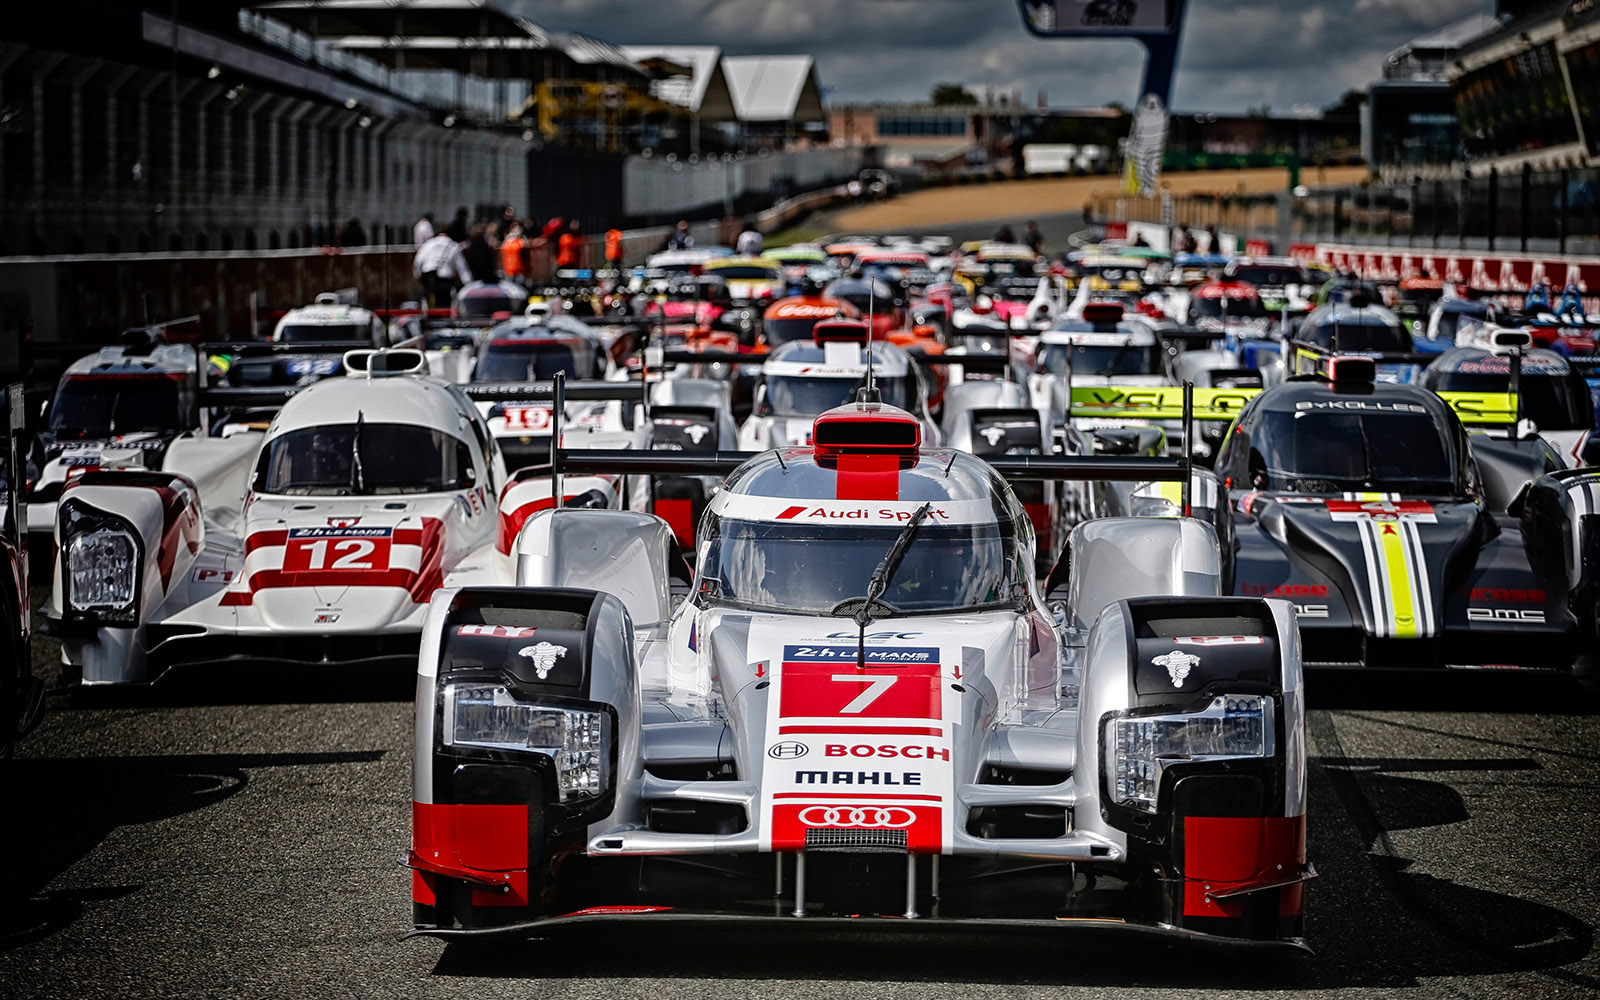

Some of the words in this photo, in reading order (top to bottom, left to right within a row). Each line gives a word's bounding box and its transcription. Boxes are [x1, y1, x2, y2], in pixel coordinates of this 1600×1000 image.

[504, 406, 549, 429] 19
[1360, 501, 1400, 512] 4
[808, 508, 869, 519] Audi
[878, 508, 950, 522] Sprt
[344, 528, 386, 536] MANS
[300, 540, 375, 570] 12
[198, 569, 234, 582] P1
[831, 674, 898, 714] 7
[825, 744, 950, 761] BOSCH
[795, 770, 921, 786] MAHLE
